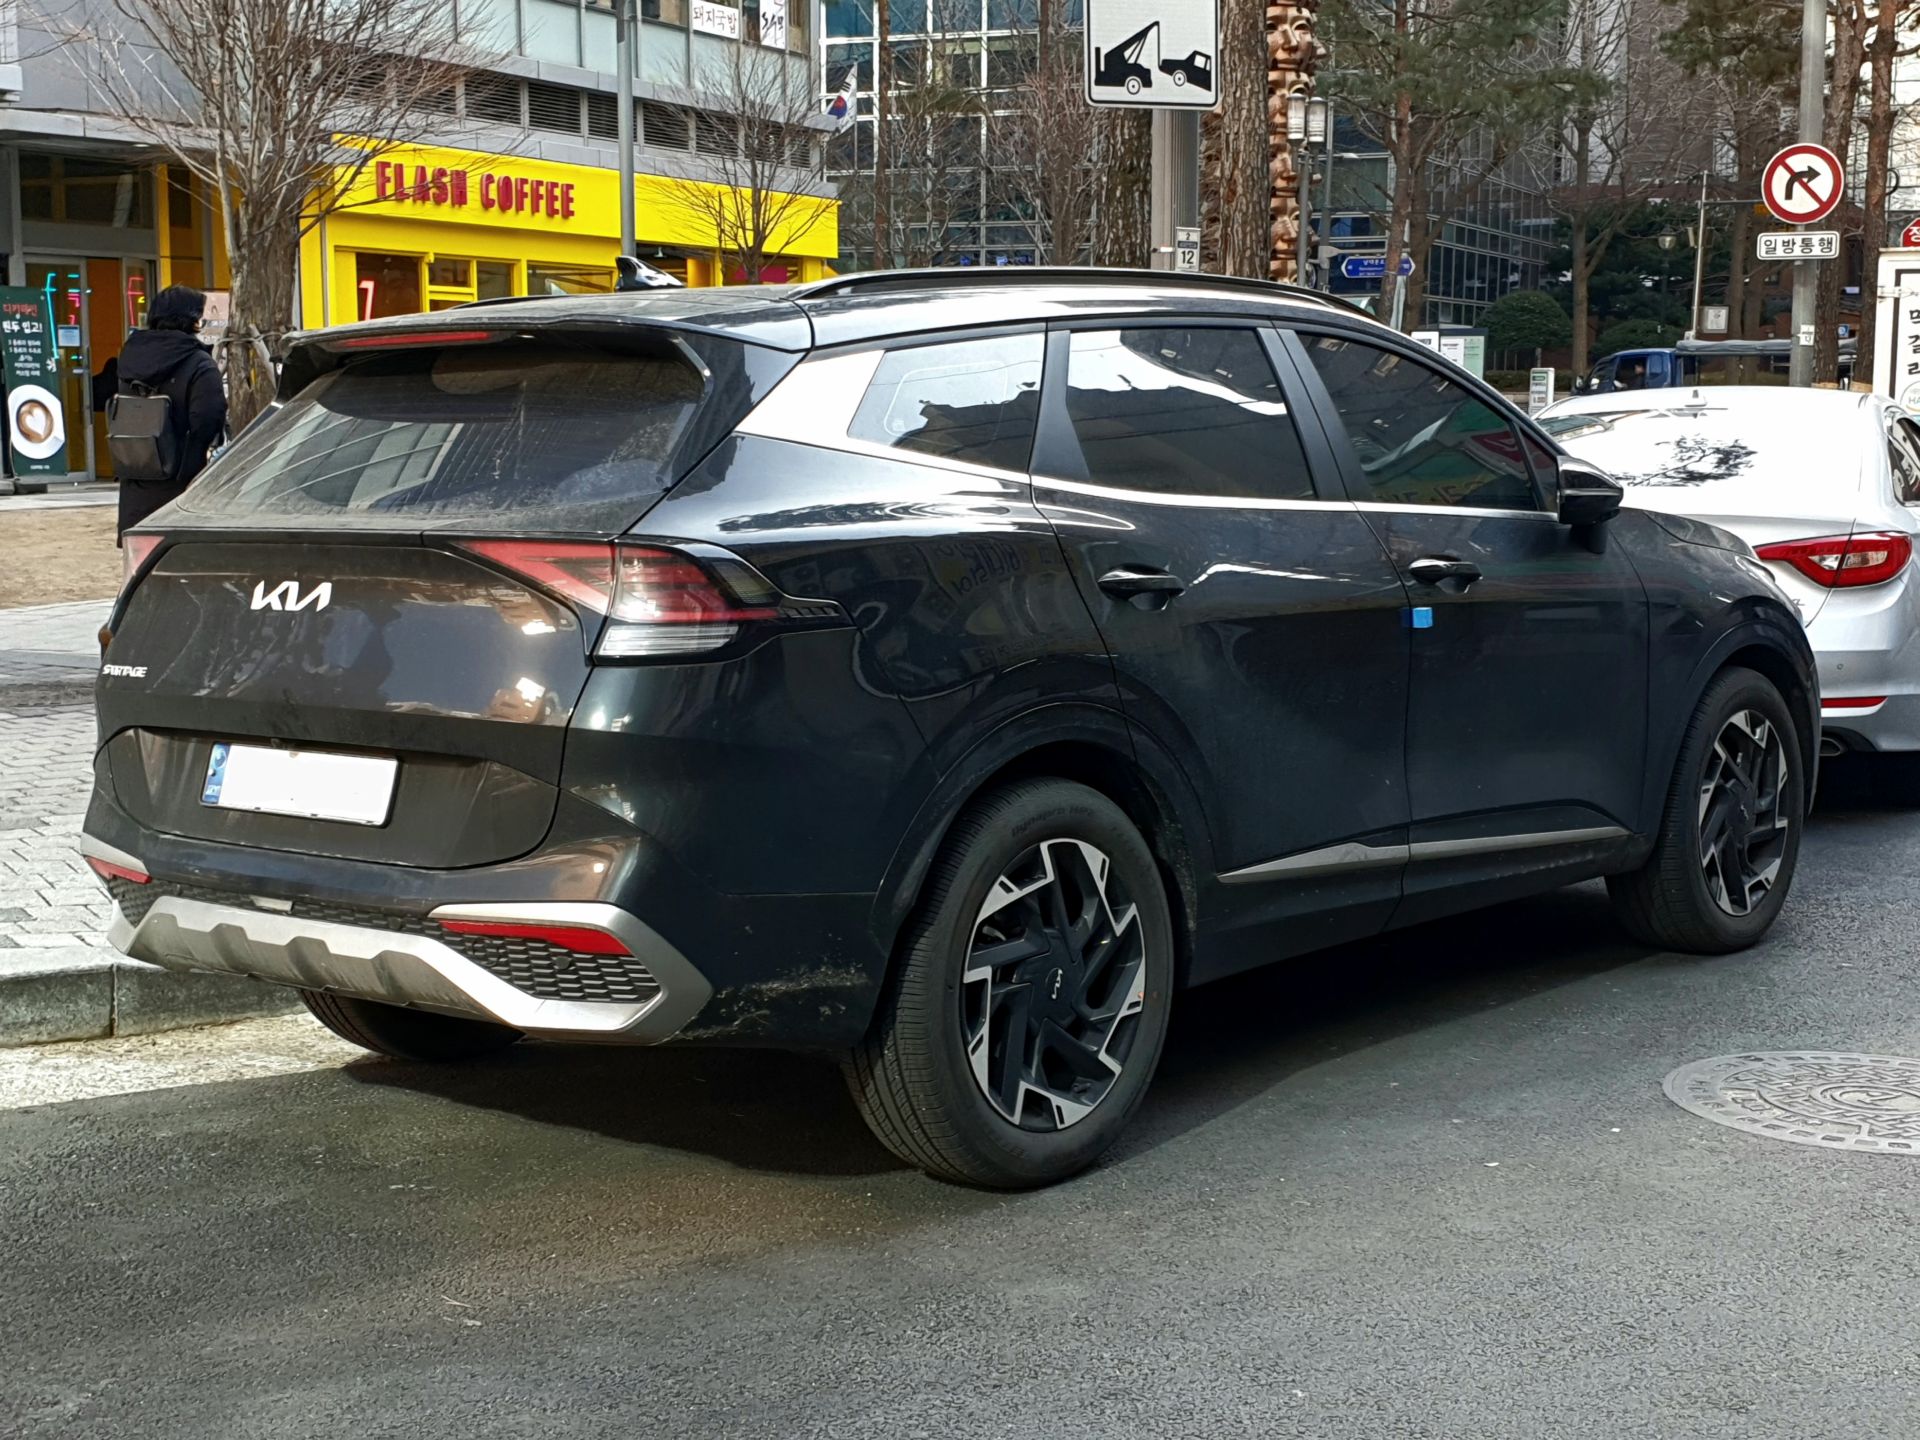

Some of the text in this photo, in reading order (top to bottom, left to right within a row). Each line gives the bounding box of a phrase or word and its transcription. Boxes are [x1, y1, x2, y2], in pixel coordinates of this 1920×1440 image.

[693, 5, 737, 34] 돼지국밥
[375, 160, 575, 219] FLASH COFFEE
[1181, 250, 1195, 265] 12
[1763, 236, 1834, 255] 일방통행
